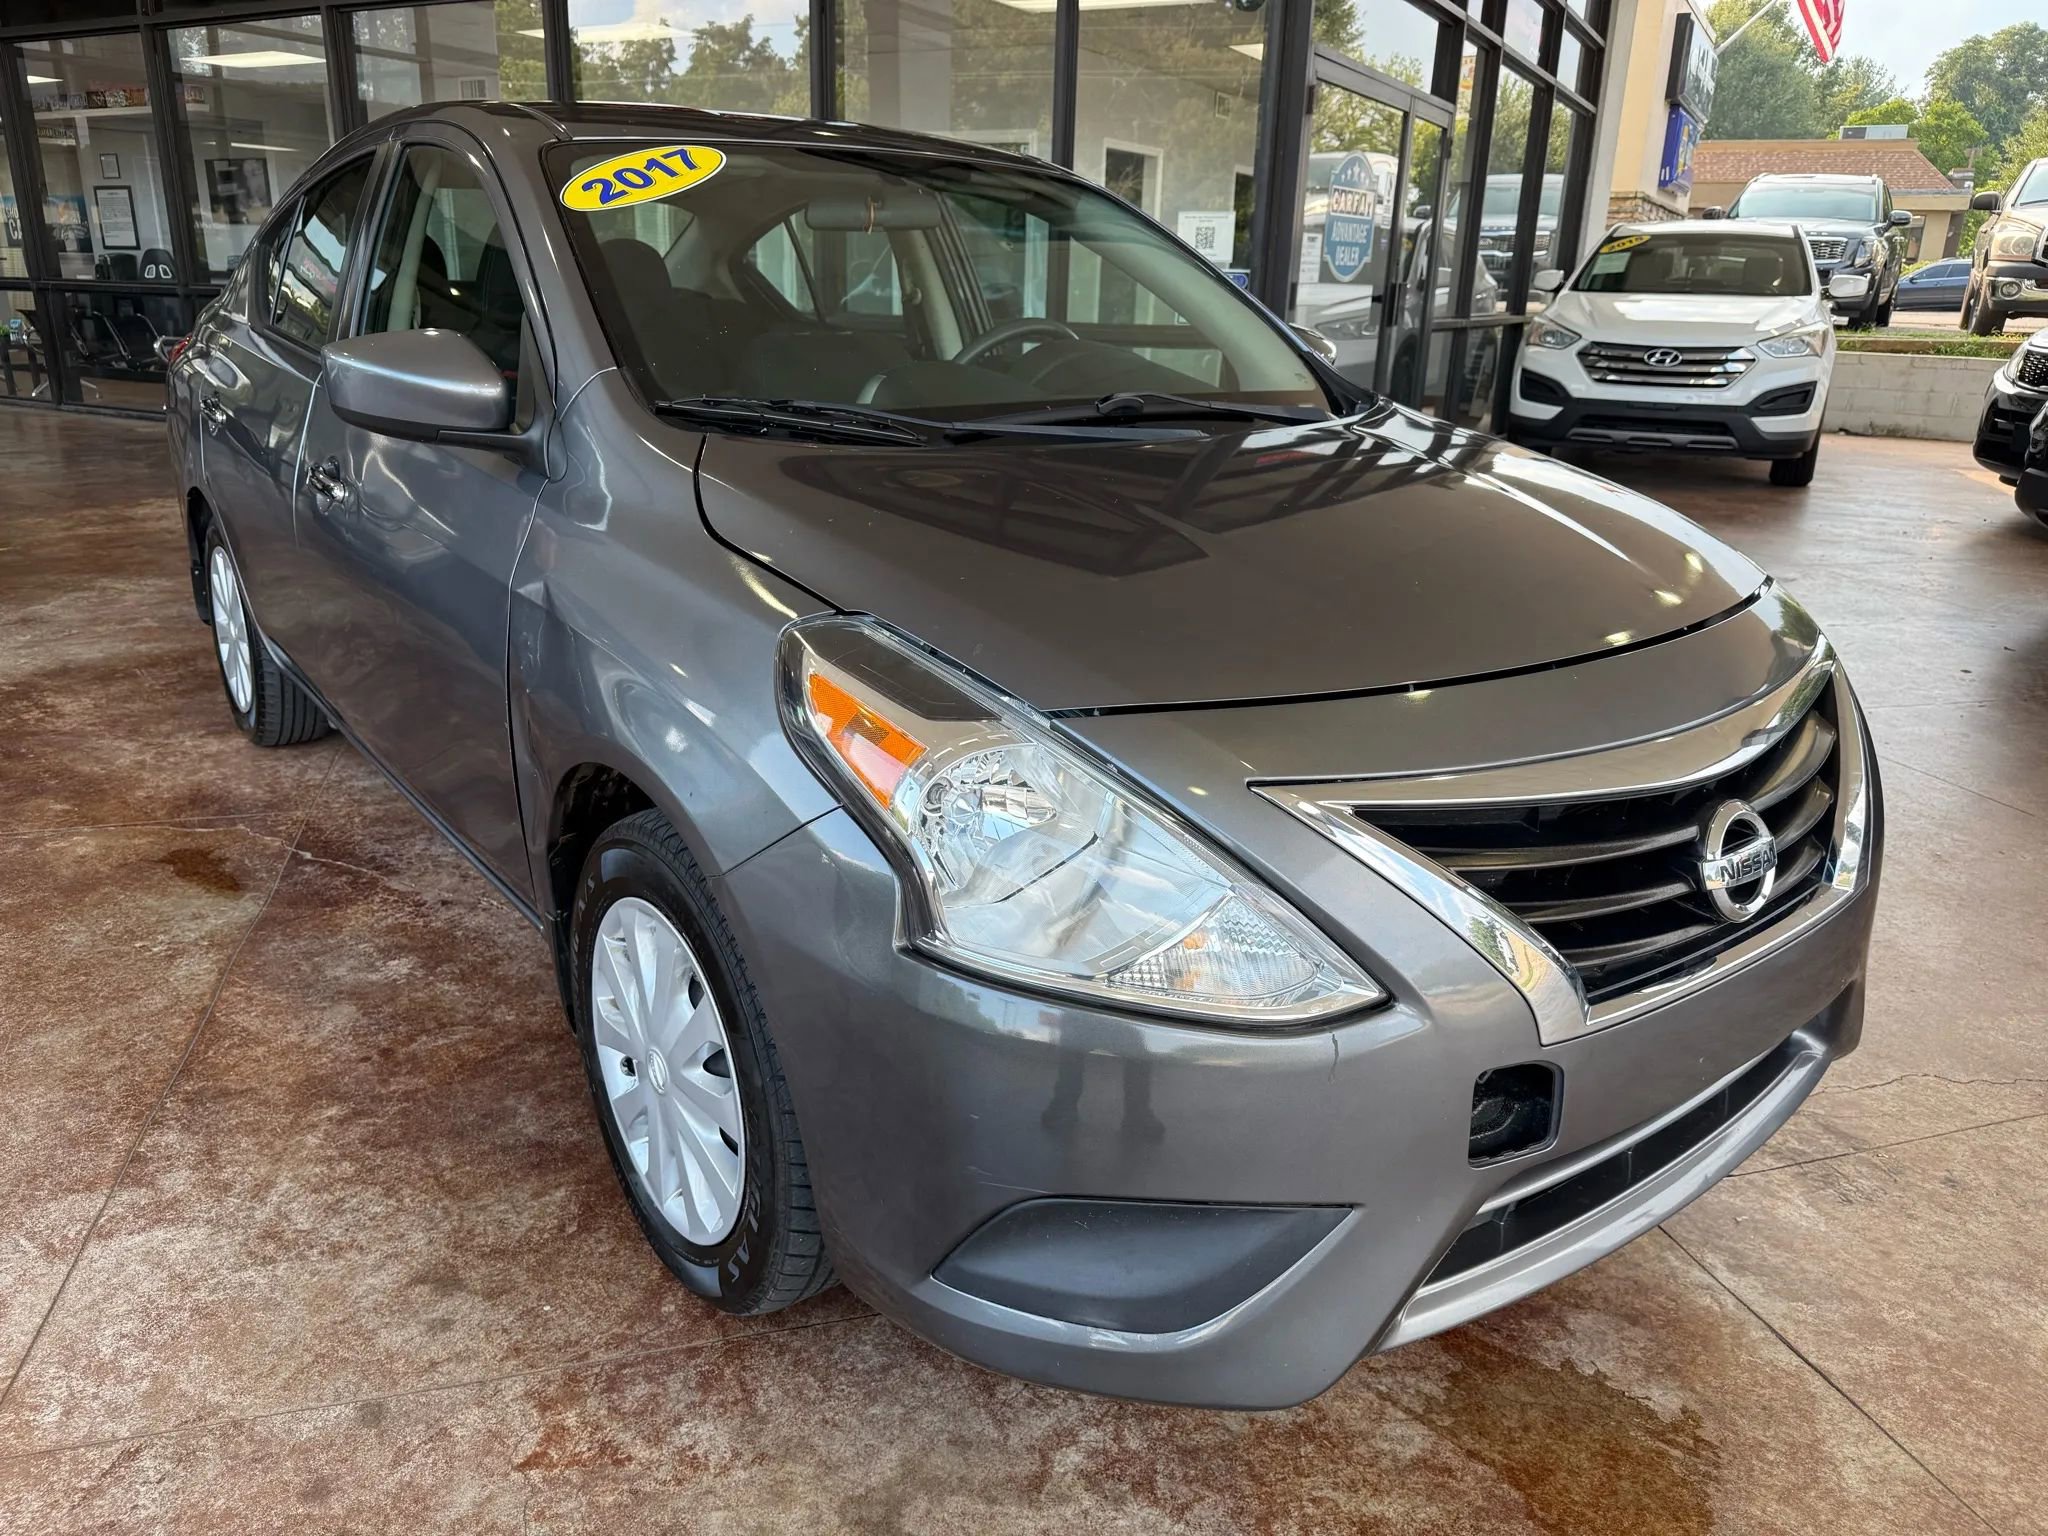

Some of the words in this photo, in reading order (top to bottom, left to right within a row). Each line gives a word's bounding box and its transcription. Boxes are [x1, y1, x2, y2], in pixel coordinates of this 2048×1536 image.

[582, 148, 703, 206] 2017
[1331, 221, 1370, 244] ADVANTAGE
[1335, 245, 1360, 267] DEALER
[1719, 843, 1777, 882] NISSAN
